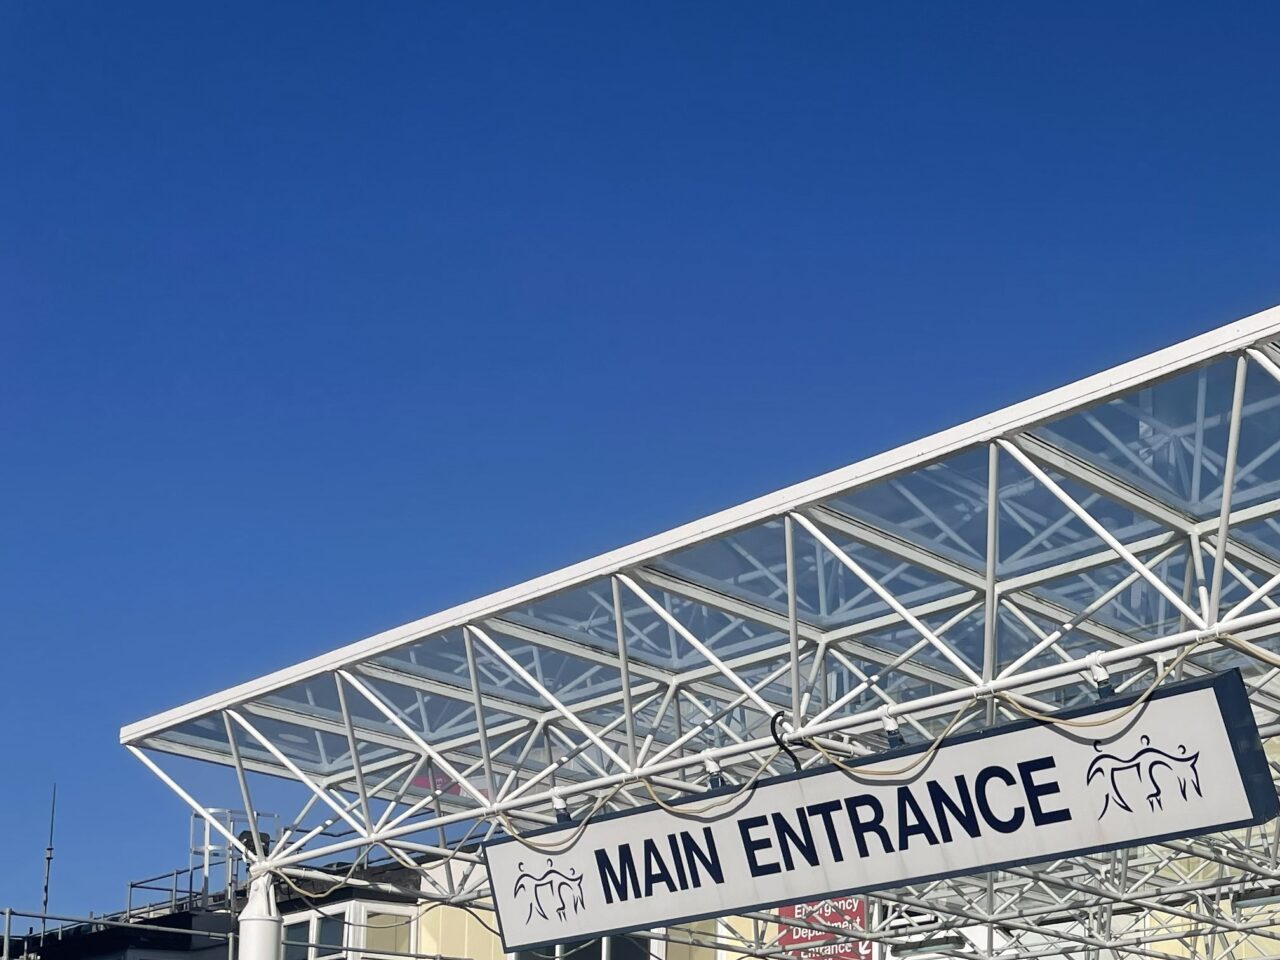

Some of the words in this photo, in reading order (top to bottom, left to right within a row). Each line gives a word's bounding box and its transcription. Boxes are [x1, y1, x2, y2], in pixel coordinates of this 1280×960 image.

[593, 825, 725, 905] MAIN
[738, 755, 1072, 878] ENTRANCE
[794, 897, 859, 919] Ergncy
[792, 914, 861, 941] Depamet
